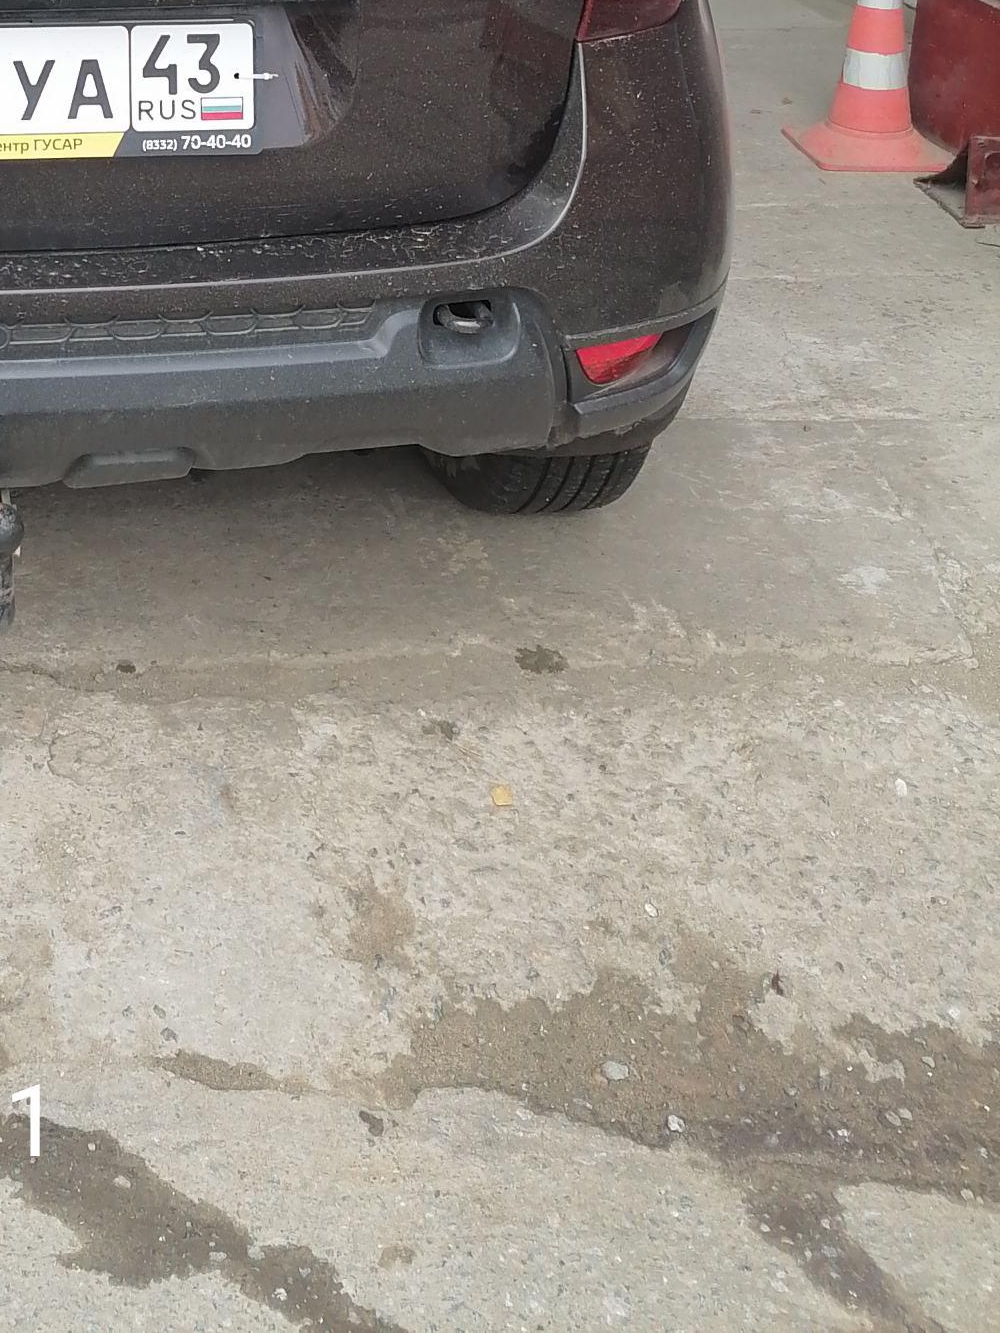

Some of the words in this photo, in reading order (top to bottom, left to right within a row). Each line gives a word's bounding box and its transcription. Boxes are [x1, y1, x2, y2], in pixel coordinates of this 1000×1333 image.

[142, 34, 221, 95] 43
[138, 99, 197, 121] RUS
[34, 138, 83, 151] ГУСАР
[142, 139, 178, 152] (8332)
[181, 134, 252, 150] 70-40-40
